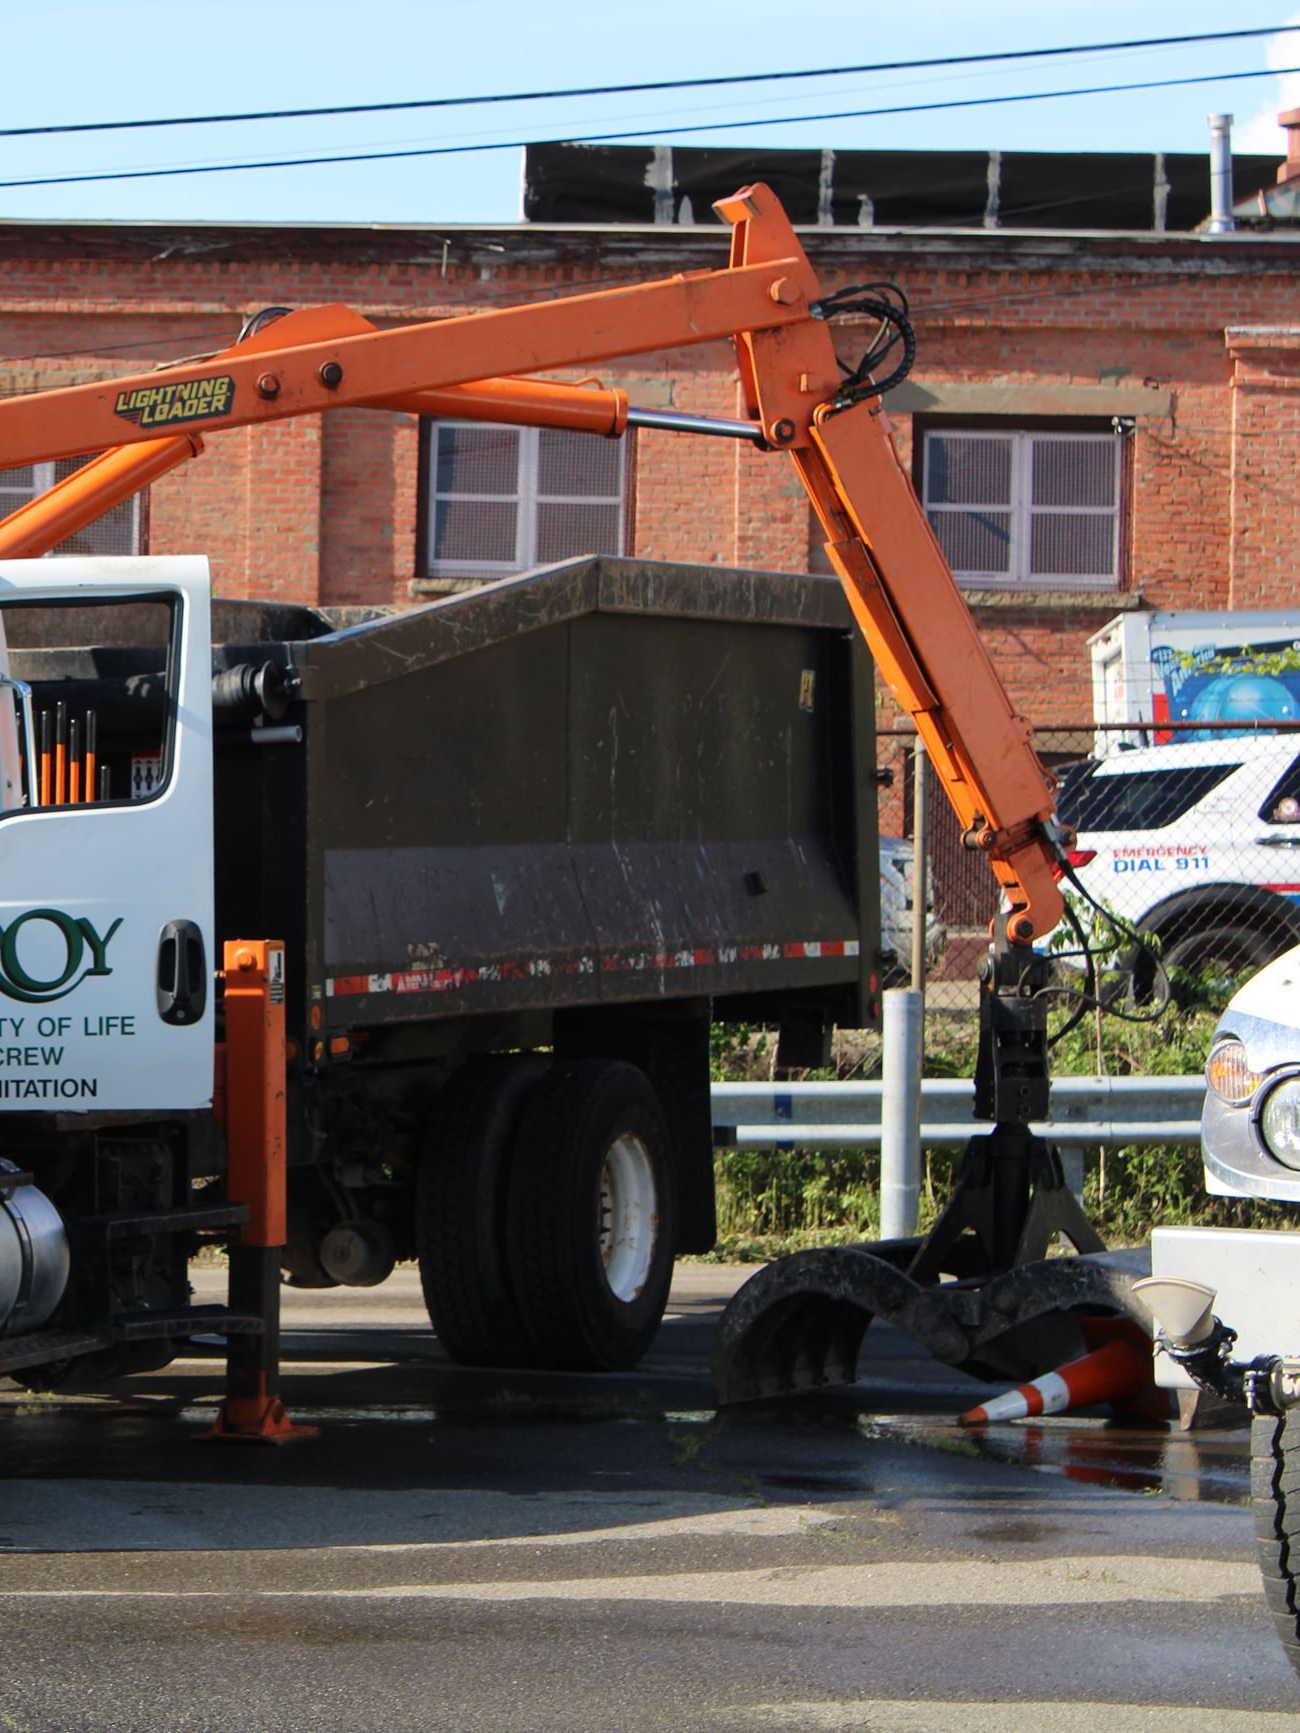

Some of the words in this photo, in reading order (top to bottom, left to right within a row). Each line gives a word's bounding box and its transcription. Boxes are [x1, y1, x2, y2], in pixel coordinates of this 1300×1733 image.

[116, 377, 230, 411] LIGHTNING
[141, 394, 226, 424] LOADER
[1113, 846, 1208, 858] EMERGENCY
[1114, 858, 1165, 873] DIAL
[1176, 857, 1209, 870] 911
[36, 1016, 73, 1038] OF
[83, 1015, 137, 1037] LIFE
